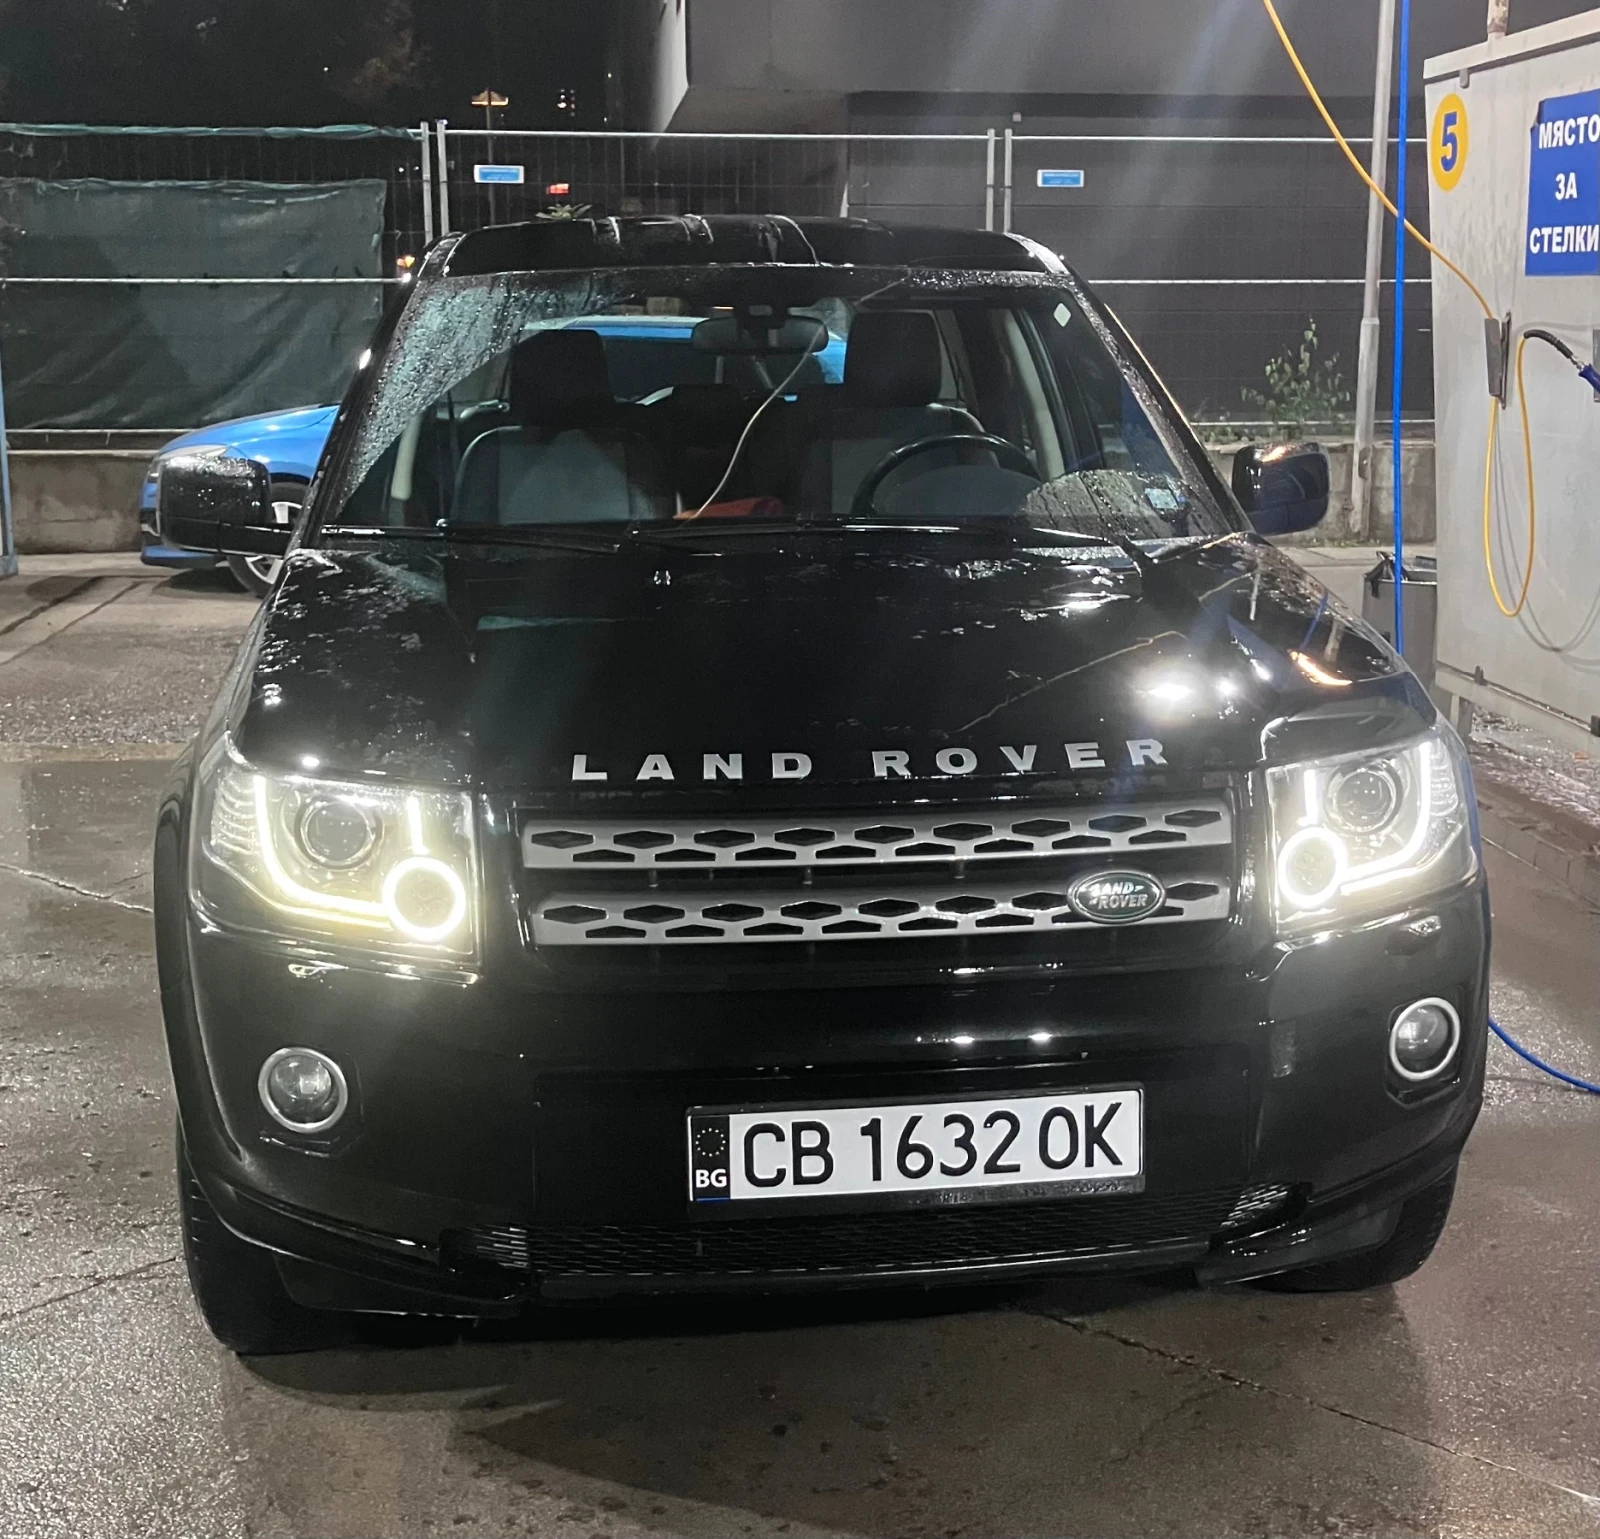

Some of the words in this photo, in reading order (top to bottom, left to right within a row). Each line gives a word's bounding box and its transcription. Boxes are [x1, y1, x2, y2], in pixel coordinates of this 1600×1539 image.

[1440, 111, 1458, 172] 5
[1539, 114, 1600, 149] МЯСТО
[1555, 172, 1578, 200] ЗА
[1529, 224, 1600, 254] СТЕЛКИ
[572, 753, 813, 781] LAND
[872, 739, 1167, 777] ROVER
[1097, 894, 1149, 909] ROVER
[743, 1120, 834, 1188] CB
[860, 1109, 1021, 1182] 1632
[1038, 1102, 1123, 1170] OK
[695, 1169, 728, 1188] BG
